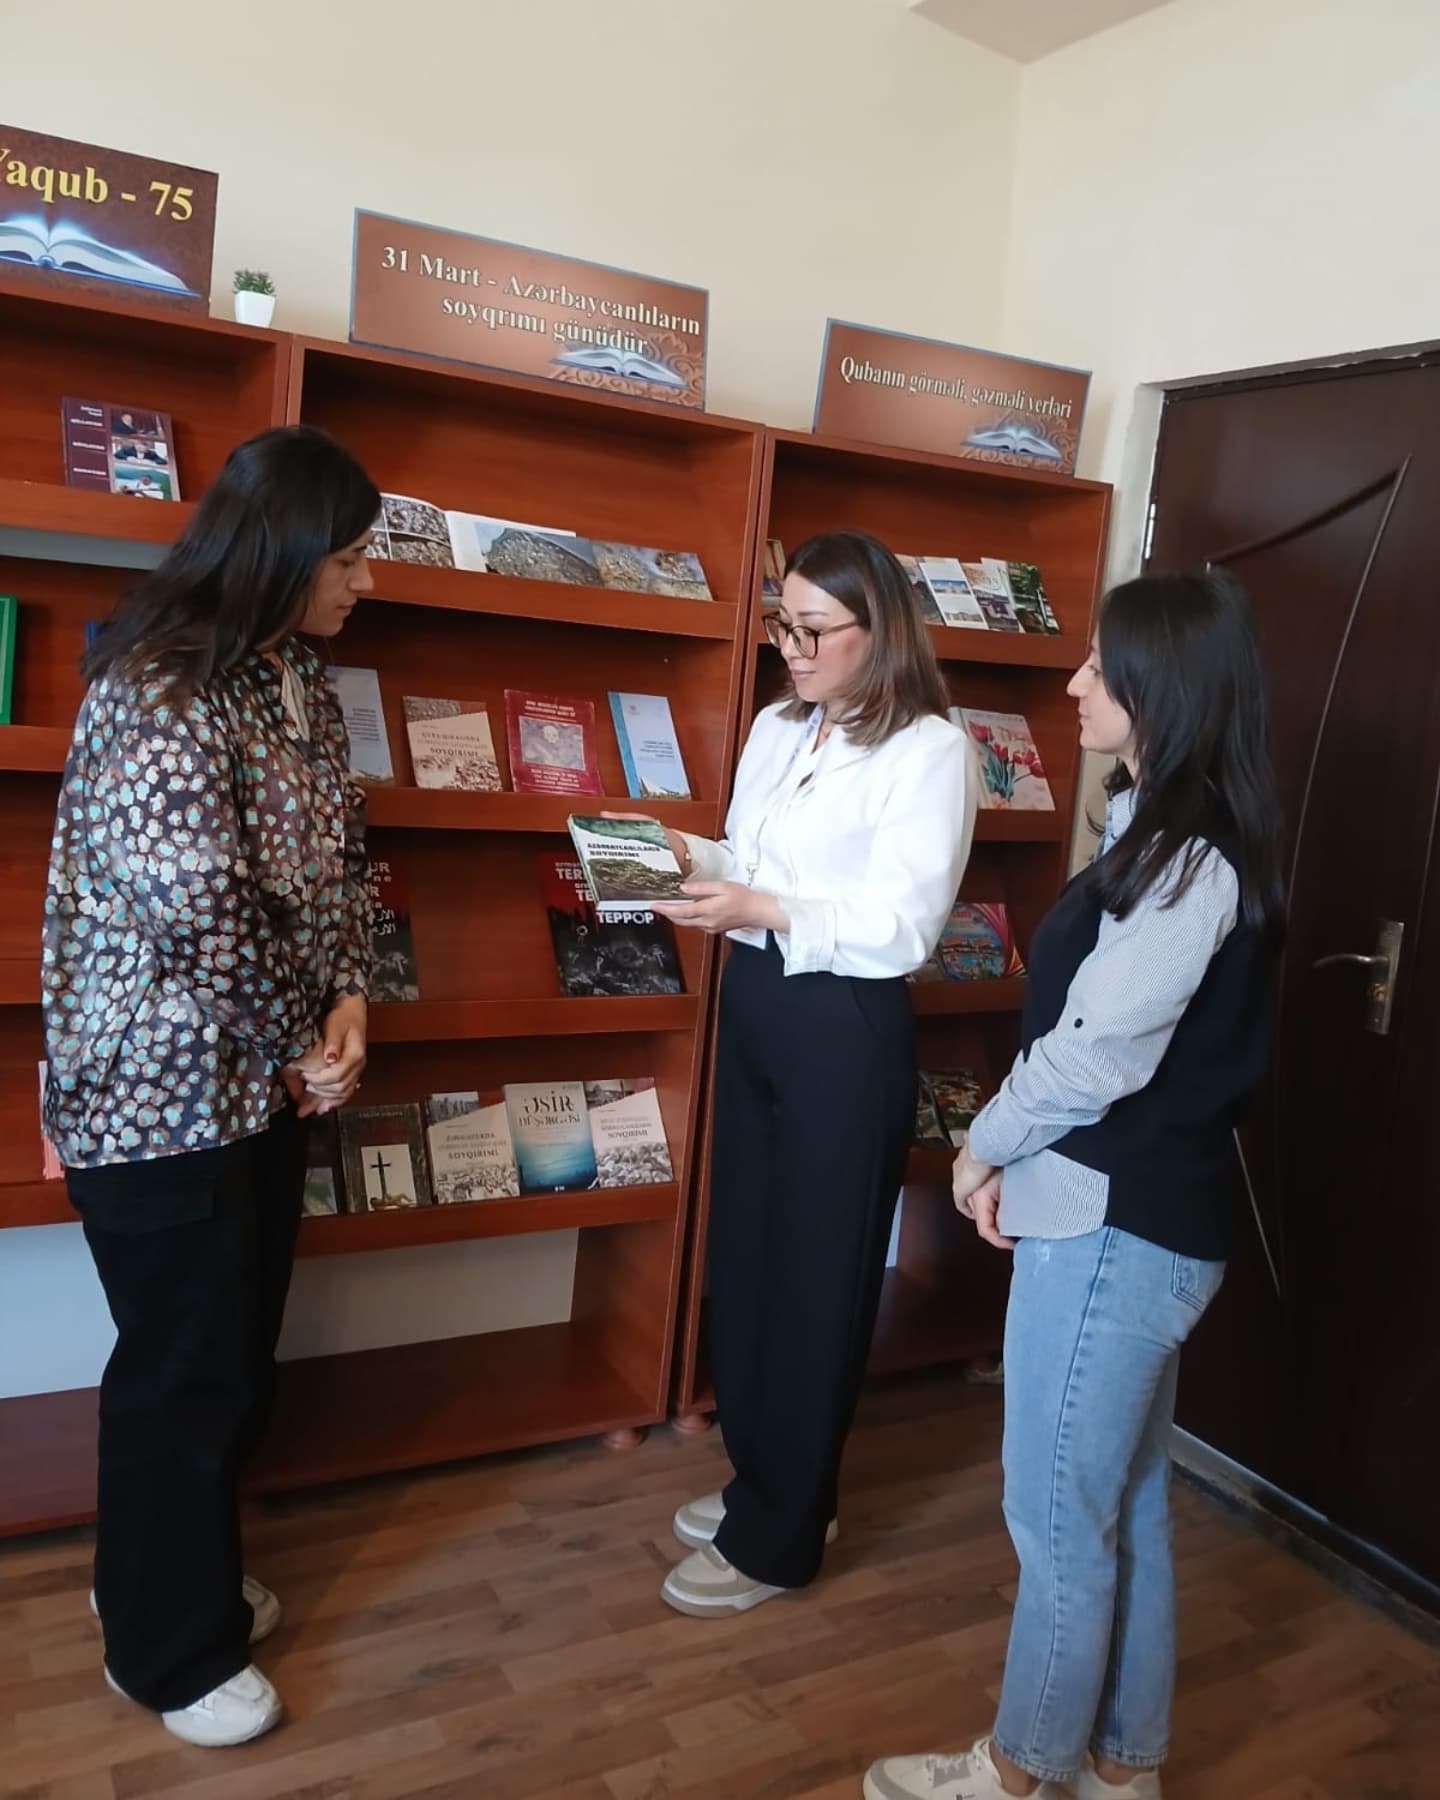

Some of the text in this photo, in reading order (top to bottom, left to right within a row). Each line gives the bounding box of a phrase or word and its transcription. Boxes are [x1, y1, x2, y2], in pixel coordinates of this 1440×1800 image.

[121, 192, 137, 202] -
[149, 181, 194, 221] 75
[381, 246, 409, 272] 31
[419, 254, 480, 287] Mart
[503, 275, 700, 336] Azərbaycanlıların
[553, 319, 649, 354] günüdür
[840, 356, 906, 388] Qubanın
[1027, 397, 1073, 419] yerləri
